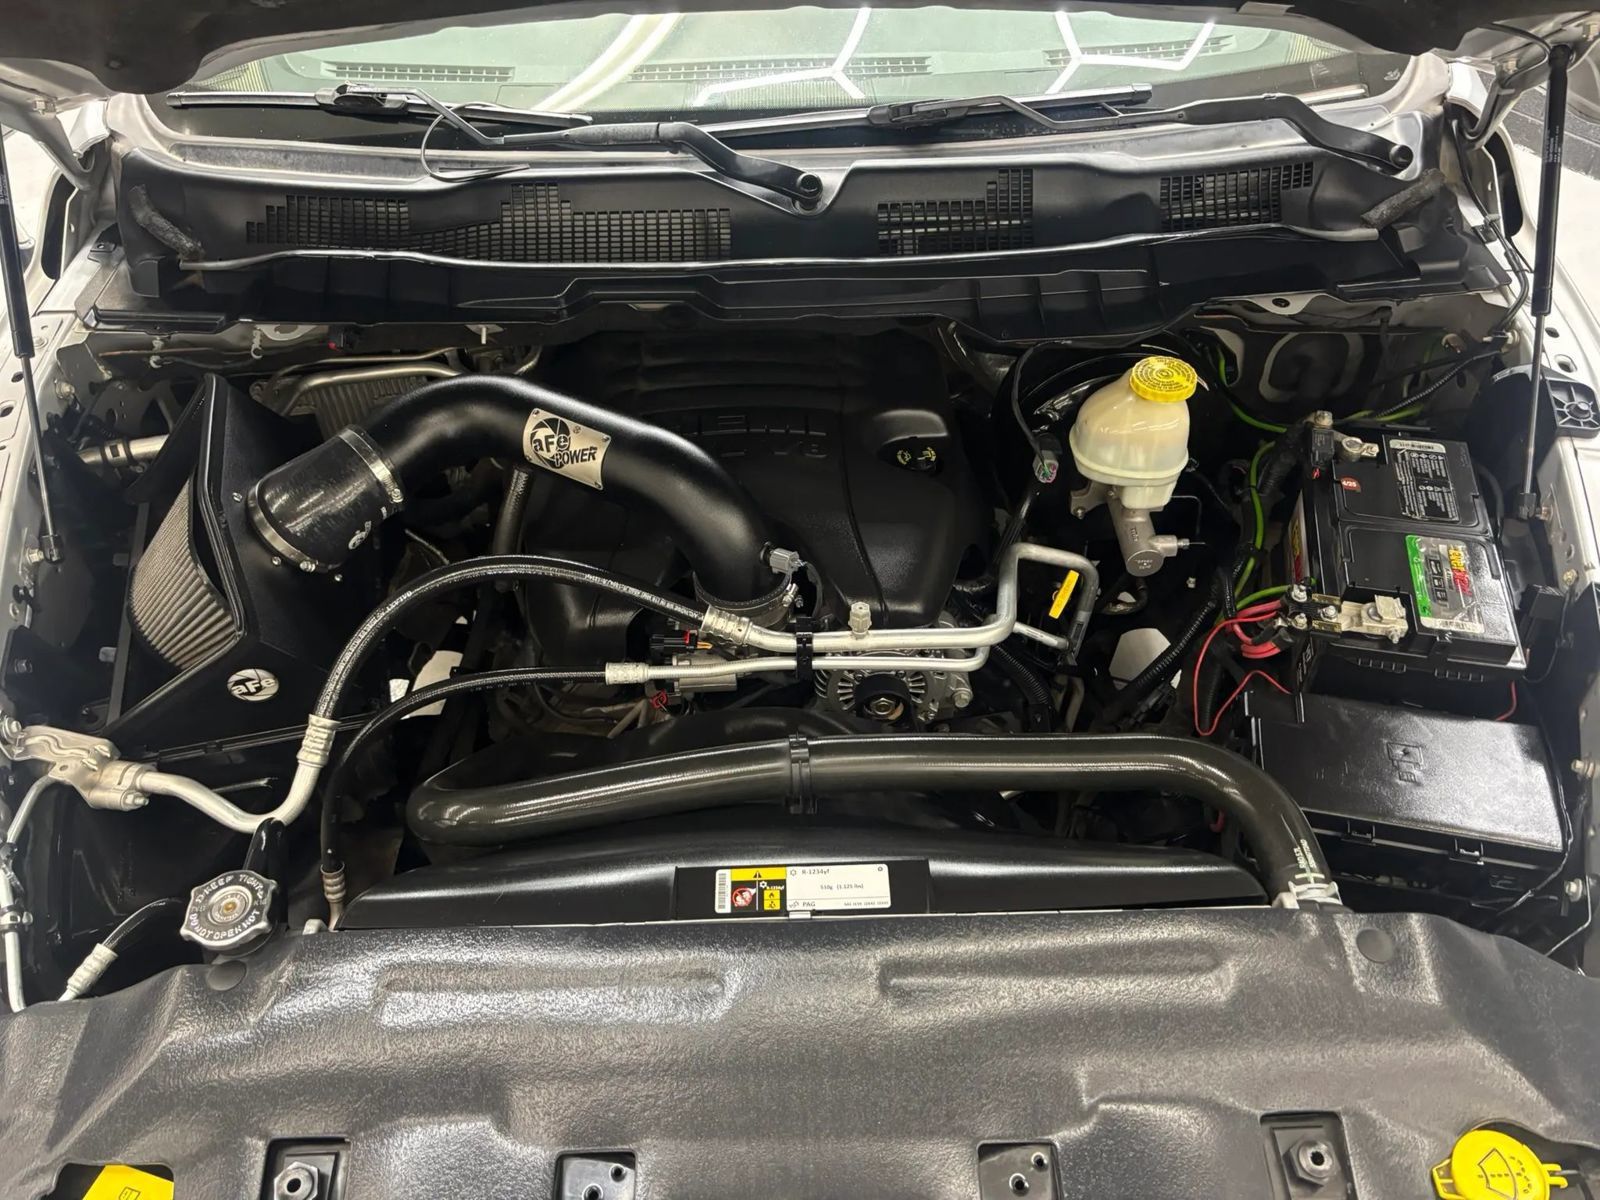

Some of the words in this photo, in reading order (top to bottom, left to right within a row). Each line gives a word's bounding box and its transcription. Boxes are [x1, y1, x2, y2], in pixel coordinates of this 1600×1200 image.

[532, 434, 570, 453] aFe
[554, 446, 598, 466] POWER
[231, 678, 276, 694] aFe
[801, 868, 830, 876] R-1234yf
[203, 875, 235, 895] KEEP
[238, 874, 264, 890] TIGHT
[213, 925, 243, 940] OPEN
[242, 910, 260, 929] HOT
